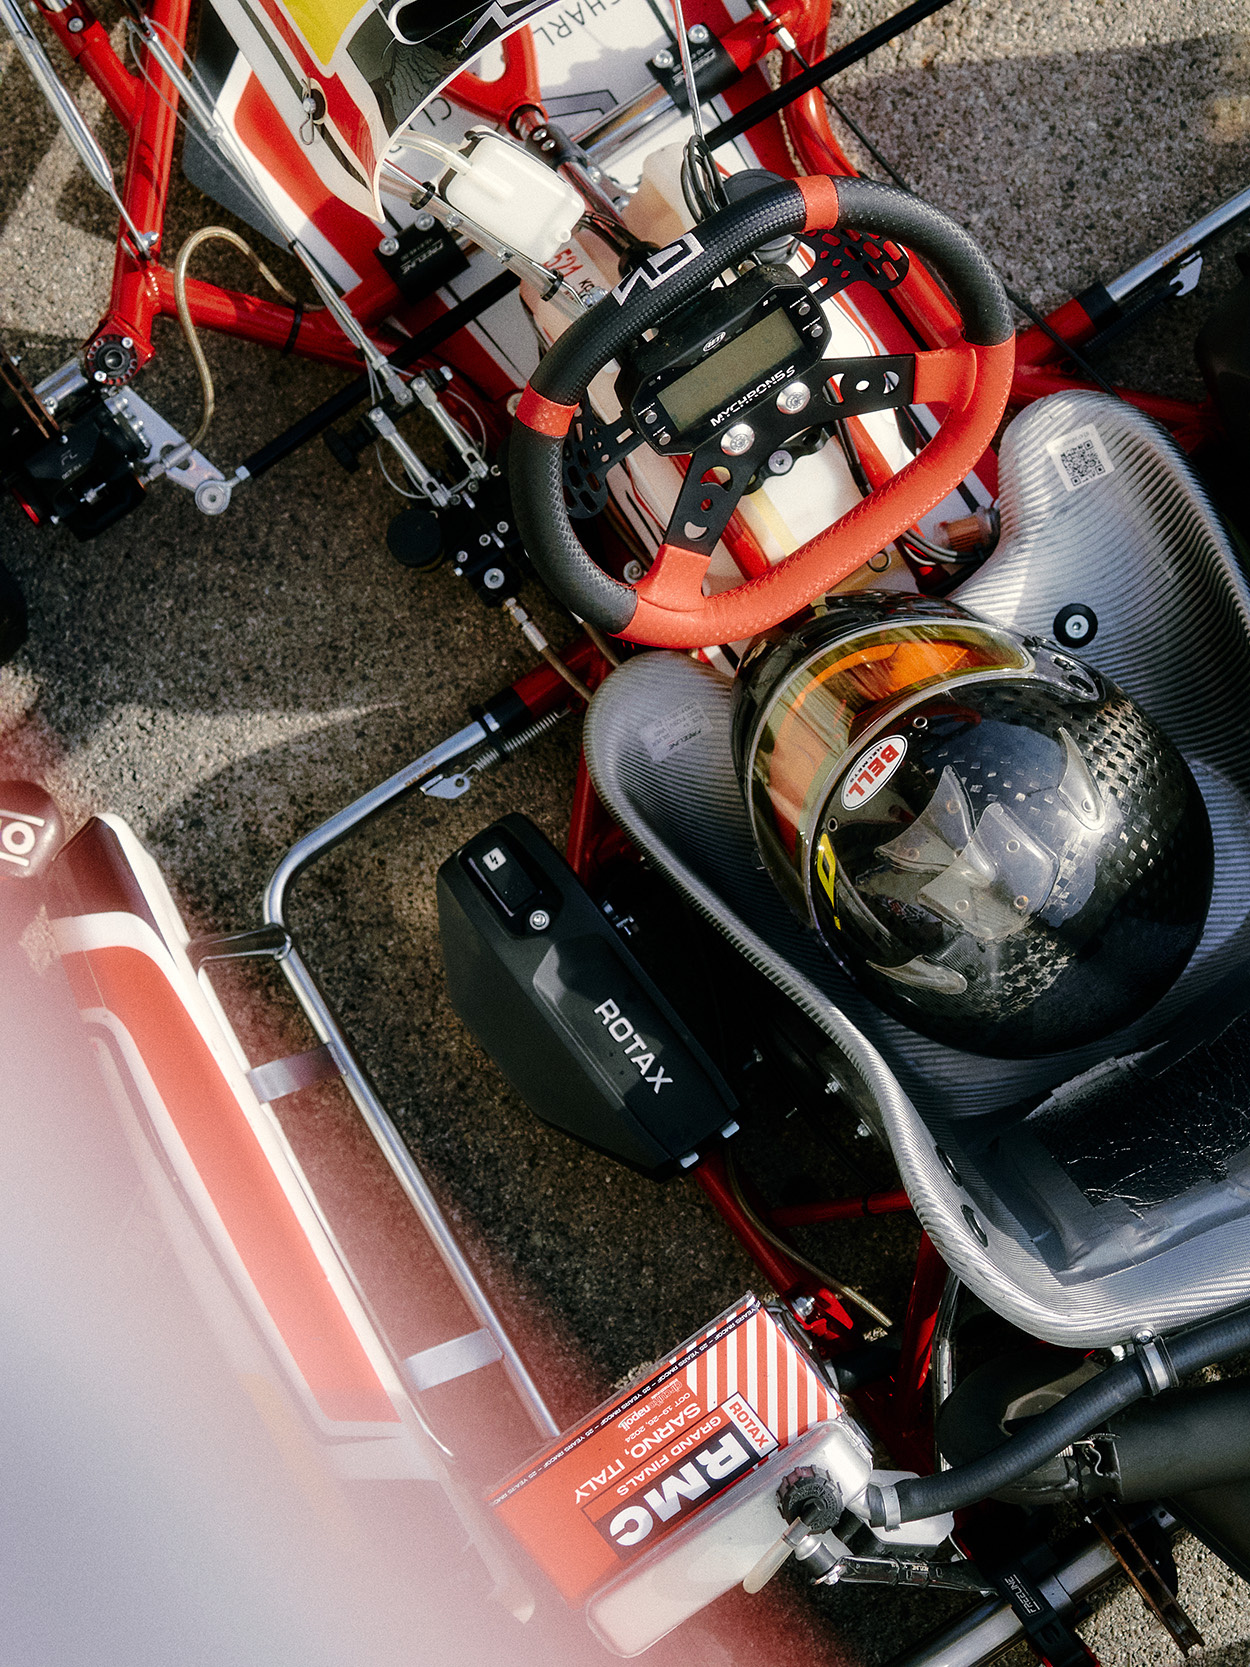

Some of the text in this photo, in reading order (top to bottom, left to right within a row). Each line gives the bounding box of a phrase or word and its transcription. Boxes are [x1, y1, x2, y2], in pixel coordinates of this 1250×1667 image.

[848, 743, 899, 796] BELL
[849, 746, 882, 783] HELMETS
[594, 998, 673, 1095] ROTAX
[734, 1307, 756, 1324] YEARS
[677, 1349, 698, 1367] YEARS
[618, 1402, 652, 1432] napoli
[619, 1392, 642, 1410] YEARS
[672, 1391, 691, 1407] OCT
[563, 1434, 585, 1452] YEARS
[624, 1425, 646, 1443] 2024
[727, 1399, 770, 1451] ROTAX
[569, 1398, 702, 1504] SARNO, ITALY
[615, 1414, 722, 1497] GRAND FINALS
[607, 1430, 751, 1547] RMC
[1004, 1575, 1037, 1613] FREELINE
